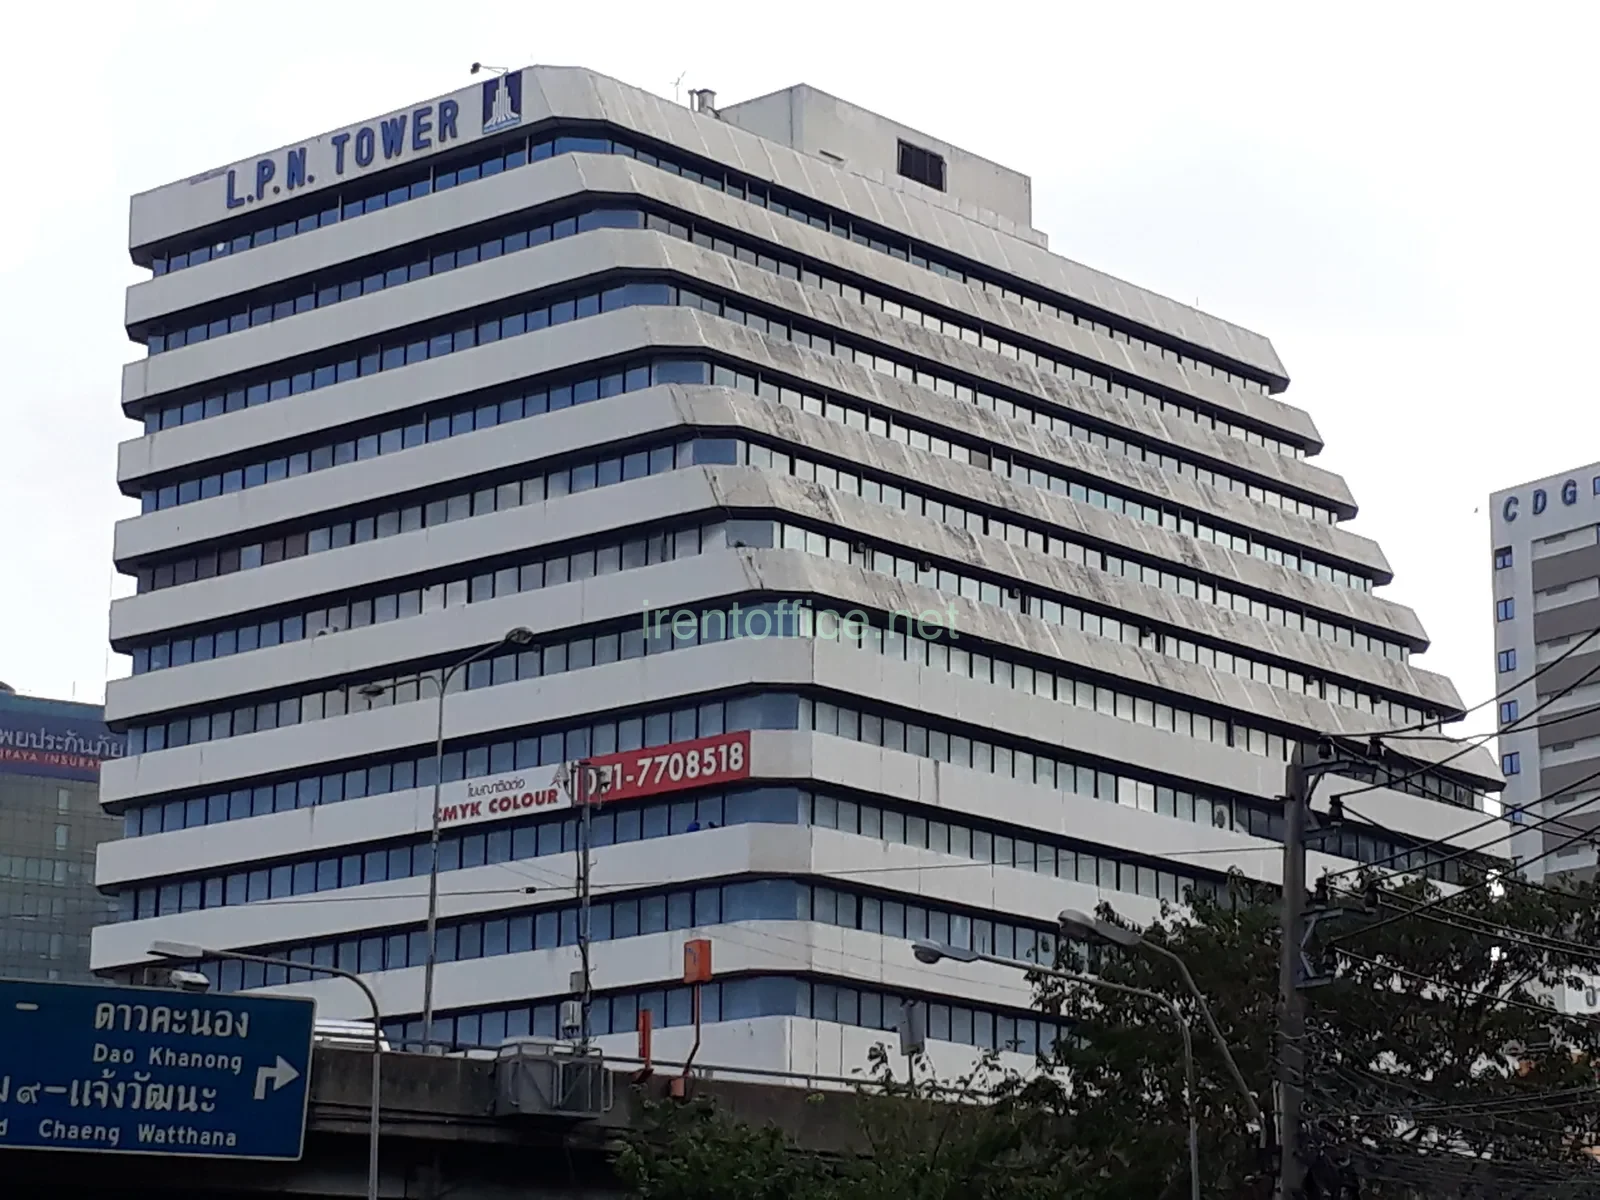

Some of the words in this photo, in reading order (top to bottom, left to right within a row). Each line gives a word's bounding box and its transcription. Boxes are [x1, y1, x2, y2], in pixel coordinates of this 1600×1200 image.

[226, 146, 315, 209] L.P.N.
[331, 99, 459, 176] TOWER
[1503, 479, 1577, 522] CDG
[488, 789, 558, 813] COLOUR
[95, 1003, 249, 1038] ดาวคะนอง
[93, 1043, 134, 1064] Dao
[149, 1046, 243, 1075] Khanong
[39, 1119, 120, 1146] Chaeng
[138, 1124, 237, 1147] Watthana
